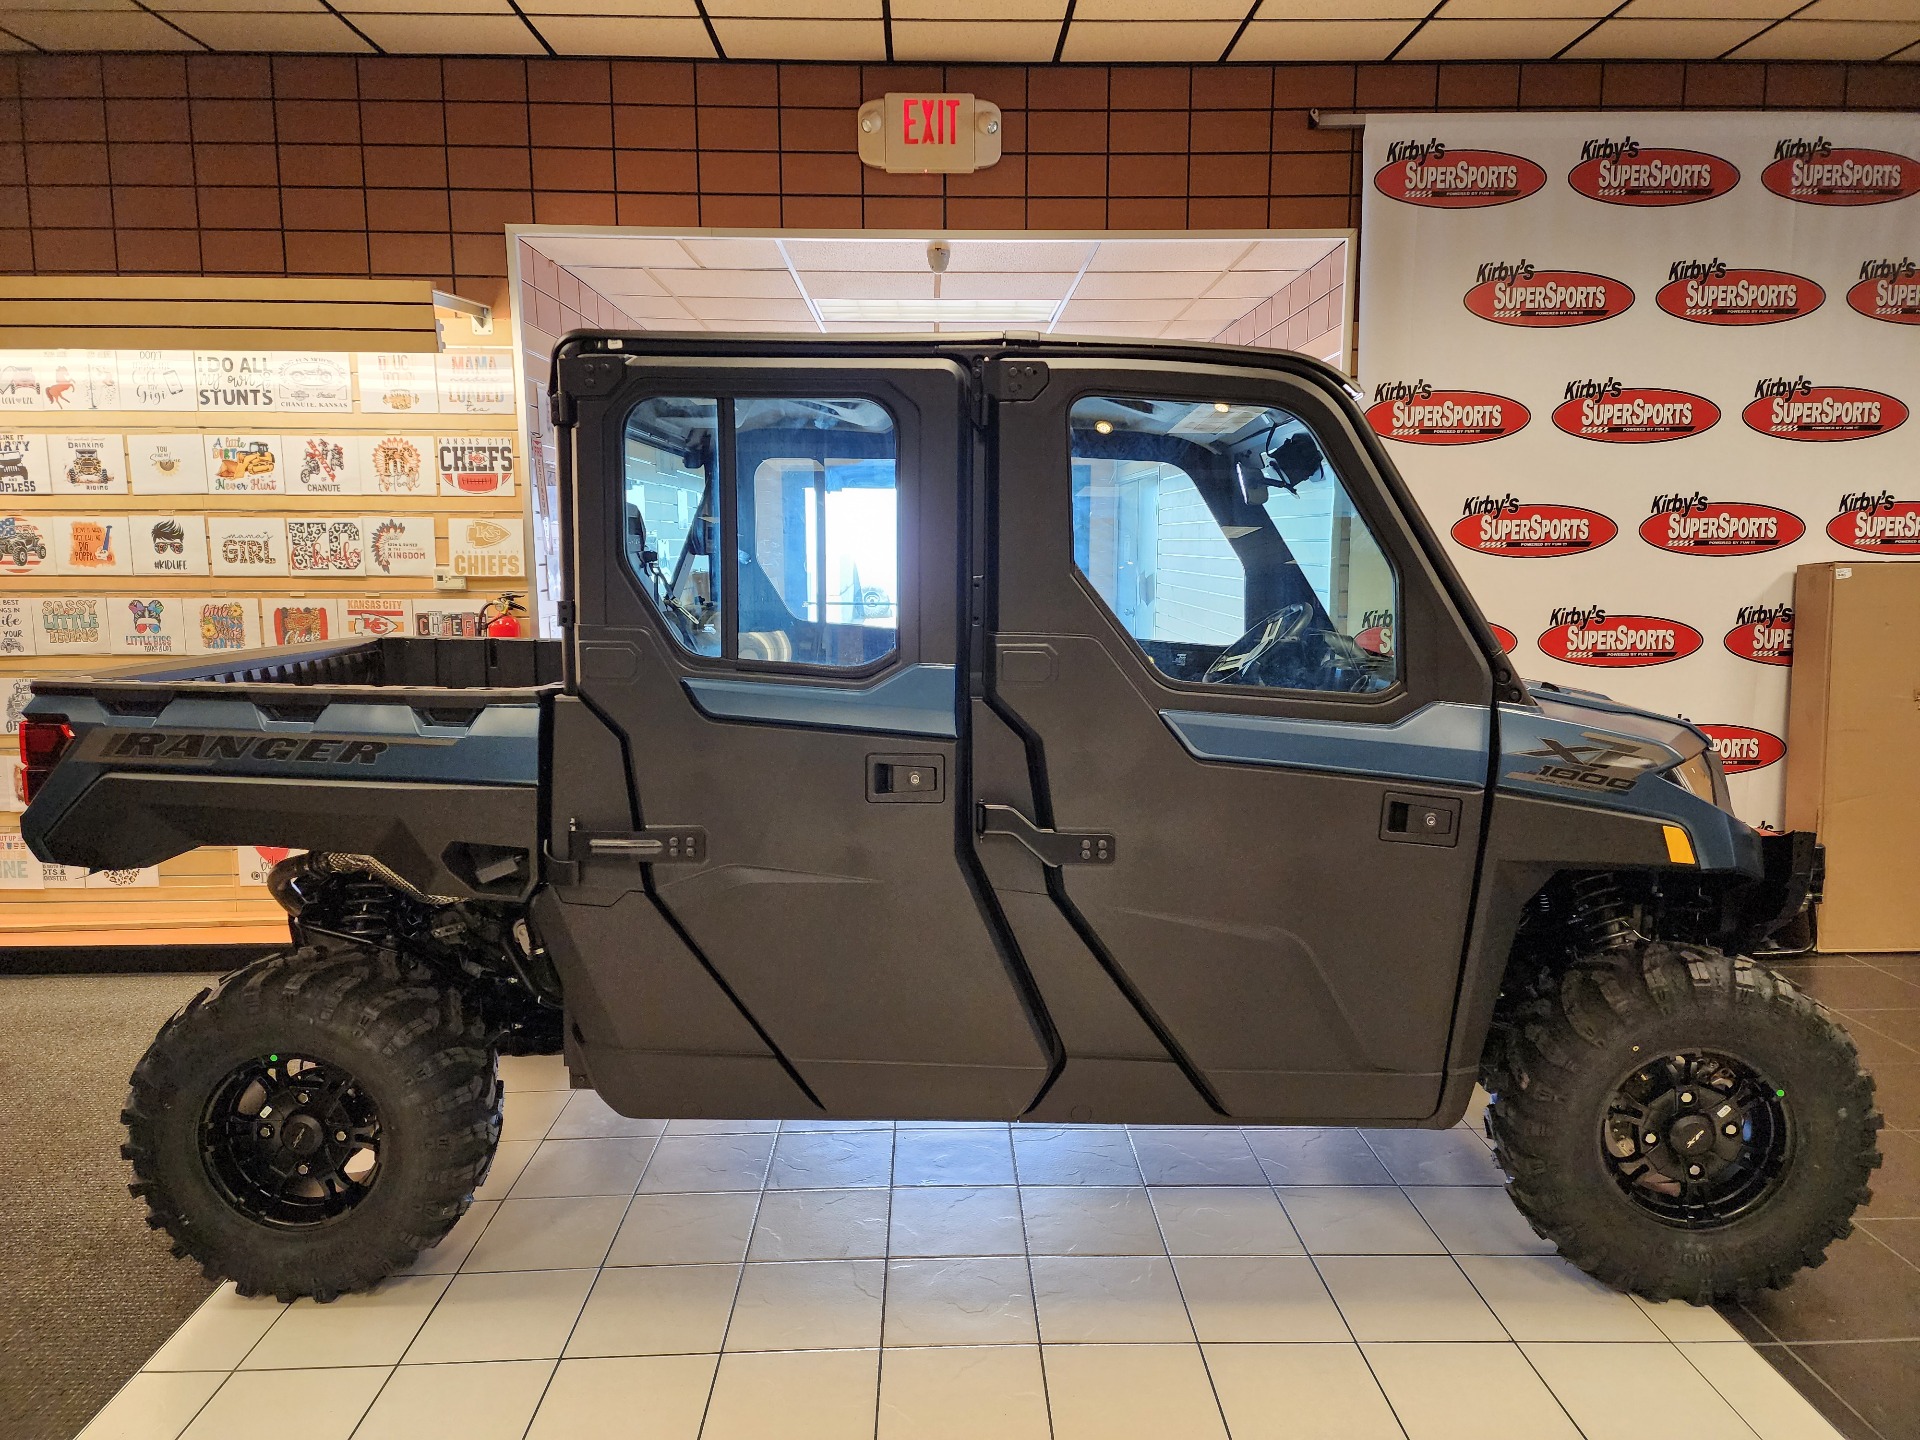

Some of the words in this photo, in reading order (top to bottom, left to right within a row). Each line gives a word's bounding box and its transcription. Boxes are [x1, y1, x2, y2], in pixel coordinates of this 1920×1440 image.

[903, 100, 960, 144] EXIT
[1386, 138, 1445, 166] Kirby's
[1580, 136, 1640, 164] Kirby's
[1774, 136, 1832, 163] Kirby's
[1476, 259, 1536, 286] Kirby's
[1668, 258, 1727, 284] Kirby's
[1859, 256, 1916, 284] Kirby's
[198, 357, 202, 372] I
[207, 357, 234, 373] DO
[240, 357, 272, 374] ALL
[452, 356, 497, 370] MAMA
[136, 386, 166, 404] Gigi
[200, 389, 273, 406] STUNTS
[1374, 379, 1433, 406] Kirby's
[1564, 376, 1622, 403] Kirby's
[1754, 376, 1812, 402] Kirby's
[212, 448, 238, 460] DIRT
[213, 438, 222, 448] A
[440, 446, 512, 472] CHIEFS
[215, 478, 248, 491] Never
[250, 478, 277, 491] Hurt
[308, 484, 341, 492] CHANUTE
[1463, 494, 1520, 520] Kirby's
[1651, 492, 1708, 518] Kirby's
[1838, 490, 1895, 516] Kirby's
[222, 540, 276, 564] GIRL
[288, 522, 362, 570] KC
[290, 542, 362, 570] Chiefs
[387, 552, 426, 560] KINGDOM
[154, 560, 188, 570] #KIDLIFE
[454, 554, 520, 576] CHIEFS
[42, 600, 97, 616] SASSY
[348, 600, 382, 610] KANSAS
[382, 600, 402, 610] CITY
[1736, 603, 1793, 628] Kirby's
[0, 614, 22, 628] ife
[43, 614, 100, 630] LITTLE
[418, 615, 486, 636] CHIEF
[1362, 610, 1393, 628] Kirb
[1550, 605, 1606, 630] Kirby's
[46, 629, 98, 644] THING
[126, 636, 152, 646] LITTLE
[113, 732, 389, 766] RANGER
[1538, 765, 1638, 791] 1000
